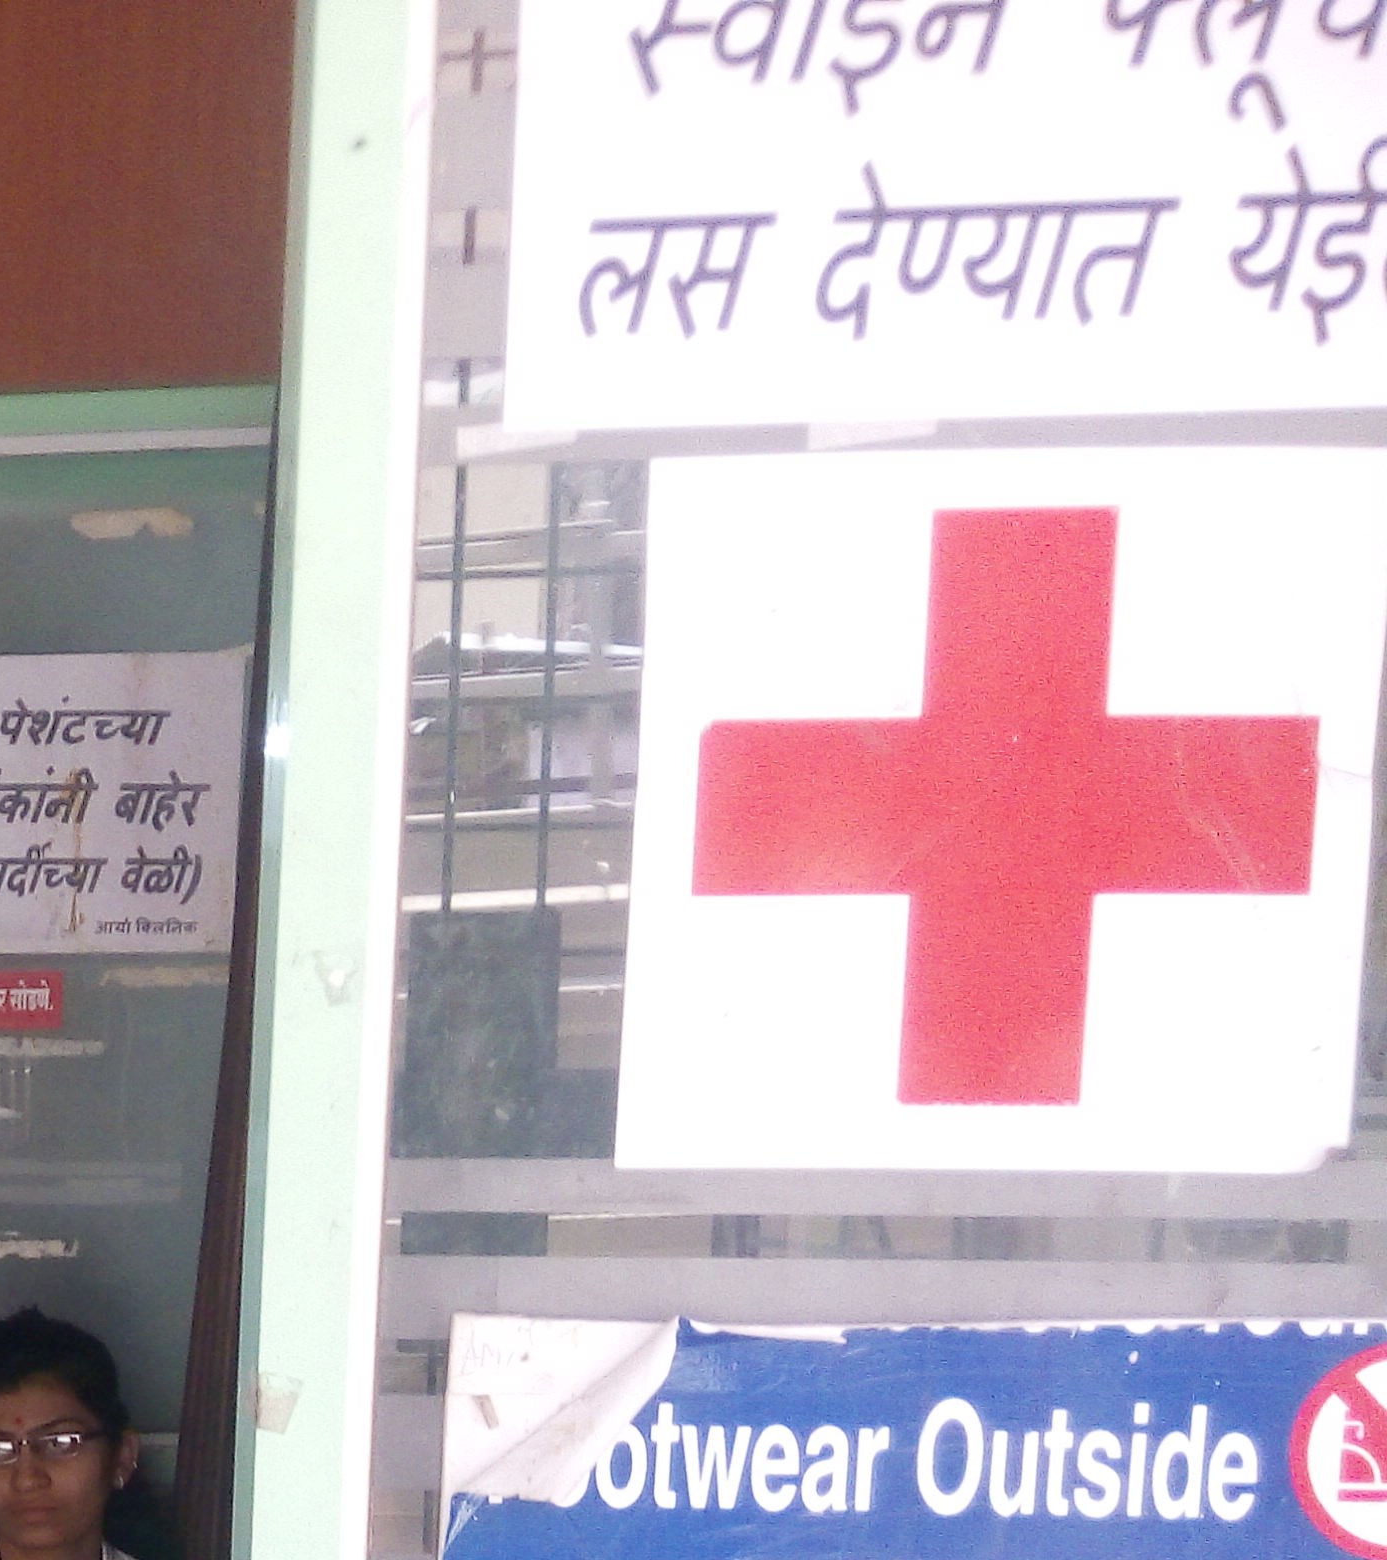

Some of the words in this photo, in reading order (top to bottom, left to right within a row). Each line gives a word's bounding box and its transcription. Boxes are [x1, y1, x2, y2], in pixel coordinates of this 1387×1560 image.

[577, 212, 779, 338] लस
[815, 160, 1182, 340] देण्यात
[1227, 136, 1387, 347] येई
[0, 695, 171, 748] पेशंटच्या
[115, 770, 211, 832] बाहेर
[120, 844, 203, 904] वेळी)
[557, 1400, 890, 1515] otwear
[916, 1397, 1259, 1521] Outside
